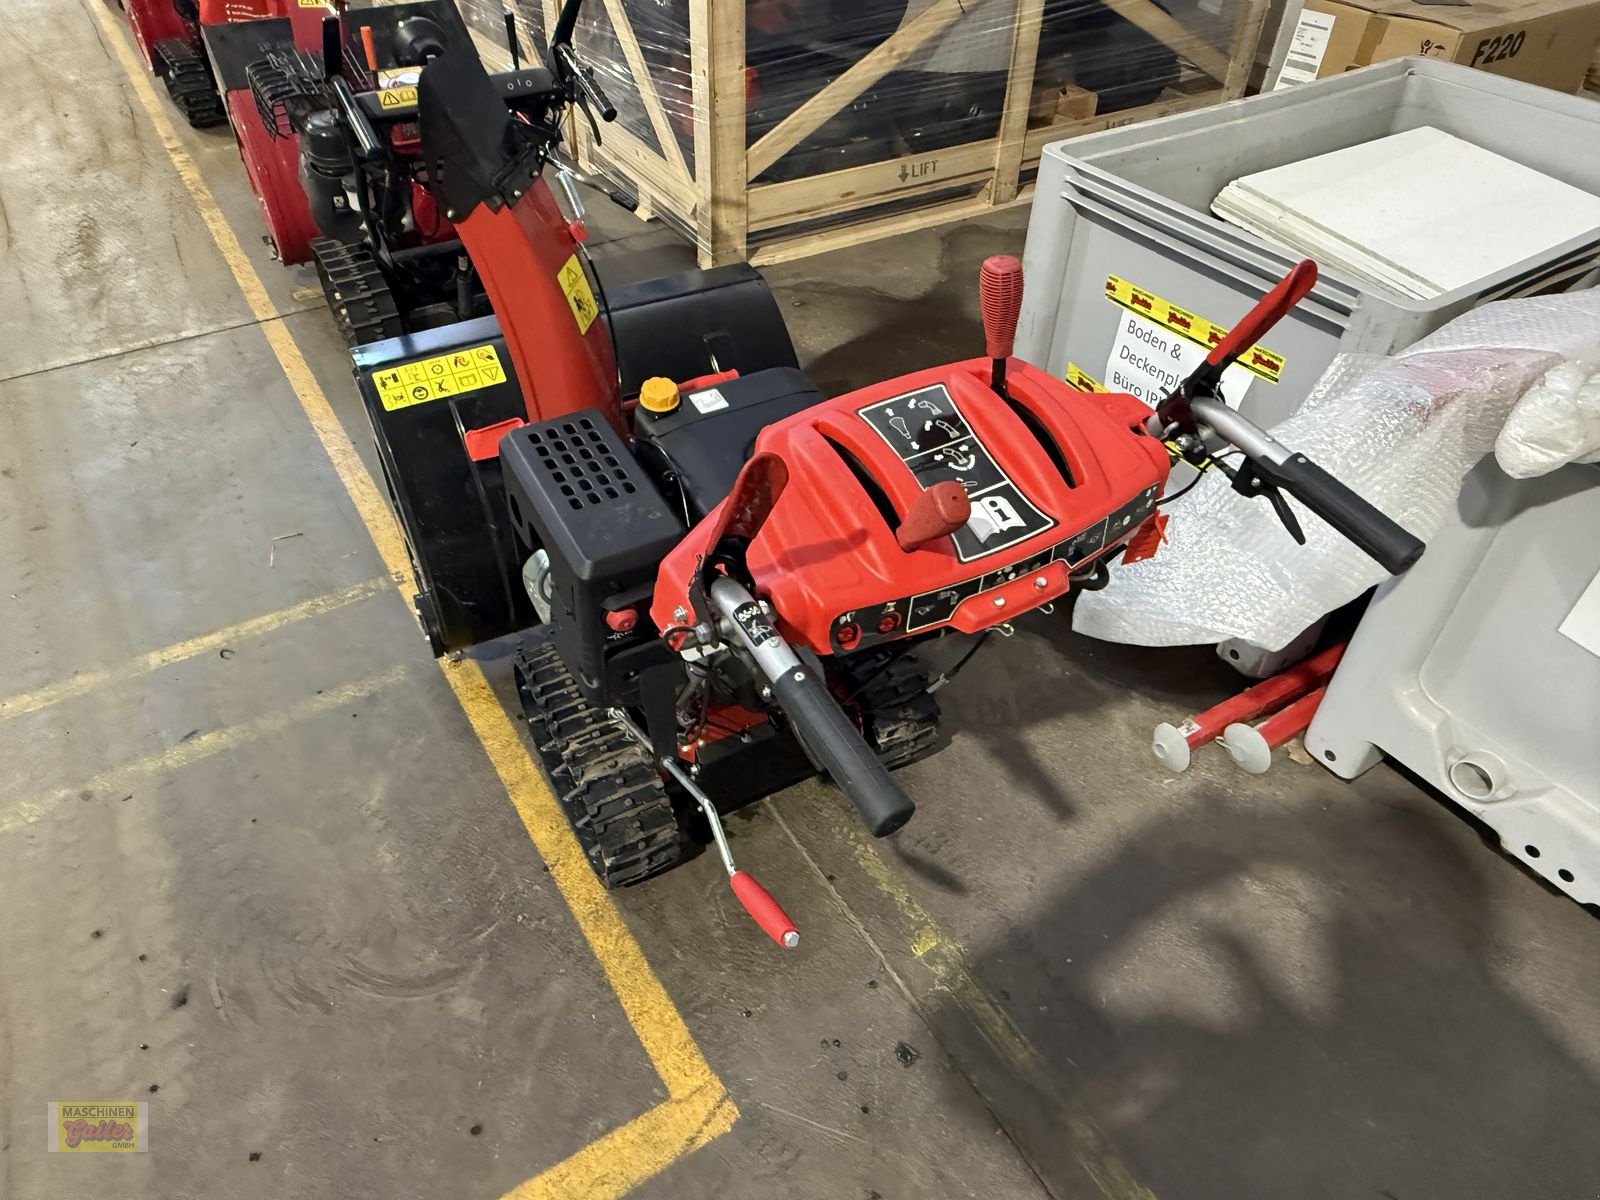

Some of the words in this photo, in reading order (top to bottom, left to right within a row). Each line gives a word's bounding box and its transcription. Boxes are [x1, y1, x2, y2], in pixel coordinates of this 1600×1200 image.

[1470, 30, 1526, 67] F220
[911, 160, 939, 178] LIFT
[1127, 319, 1167, 353] Boden
[1170, 343, 1182, 361] &
[1119, 345, 1180, 389] Deckenpl
[1112, 370, 1143, 398] Büro
[1144, 389, 1162, 404] IP
